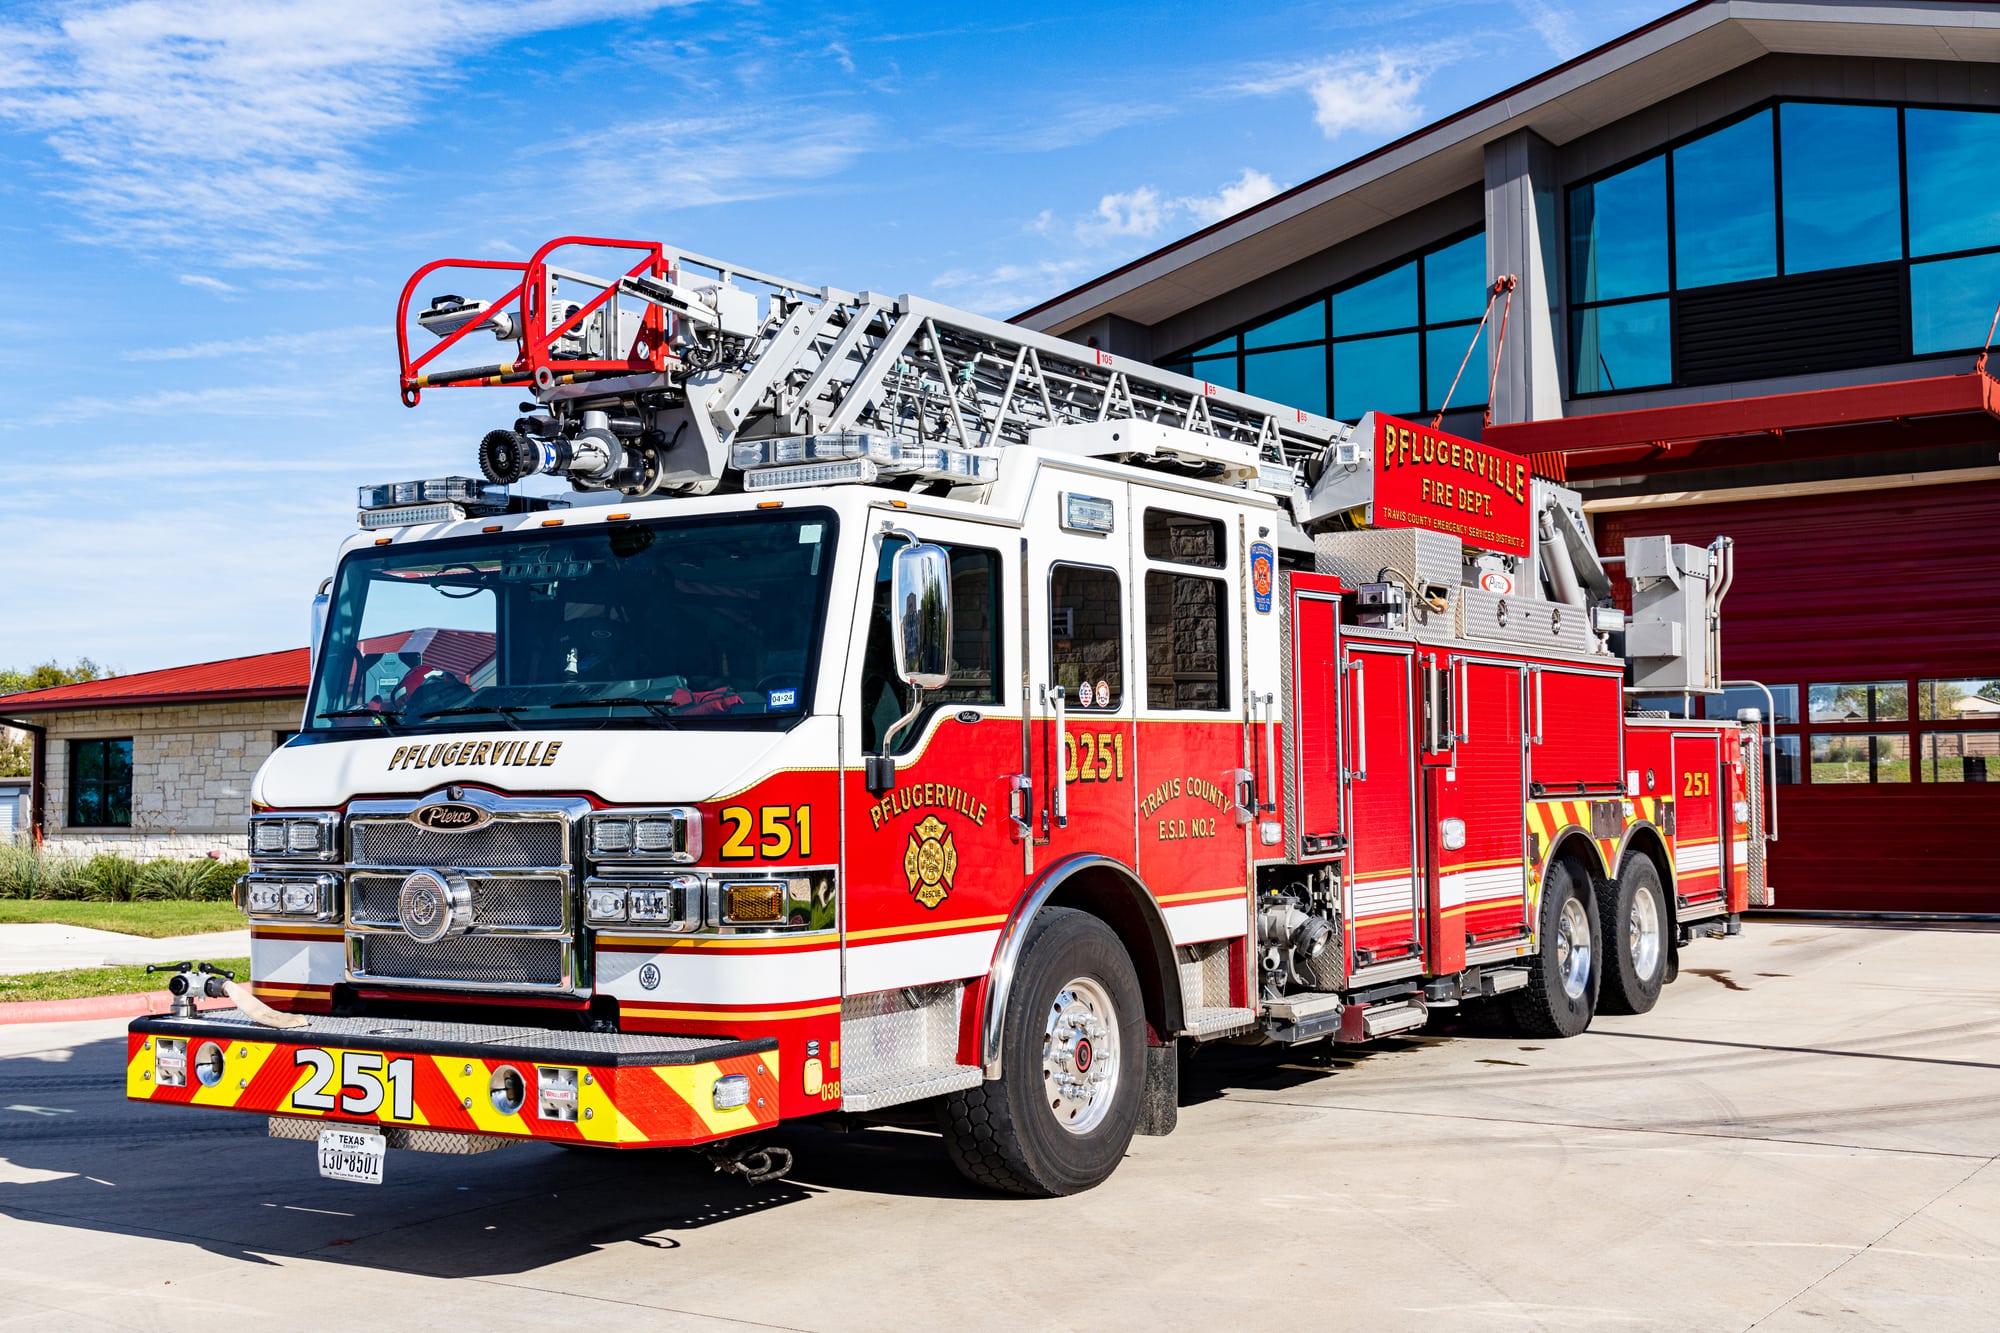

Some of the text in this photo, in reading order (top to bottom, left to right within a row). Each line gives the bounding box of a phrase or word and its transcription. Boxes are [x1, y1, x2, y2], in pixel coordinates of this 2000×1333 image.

[1101, 354, 1112, 365] 105
[1208, 385, 1217, 395] 95
[1384, 424, 1525, 504] PFLUGERVILLE
[1421, 478, 1493, 518] FIRE DEPT.
[1383, 507, 1406, 522] TRAVIS
[1407, 513, 1432, 527] COUNTY
[1433, 518, 1468, 535] EMERGENCY
[1468, 526, 1495, 541] SERVICES
[1495, 533, 1521, 546] DISTRICT
[388, 741, 563, 770] PFLUGERVILLE
[1140, 776, 1231, 819] TRAVIS COUNTY
[1683, 771, 1710, 798] 251
[428, 807, 471, 825] Pierce
[870, 783, 987, 831] PFLUGERVILLE
[719, 804, 811, 861] 251
[924, 825, 937, 833] FIRE
[1159, 820, 1187, 841] E.S.D.
[922, 890, 941, 899] RESCUE
[292, 1048, 414, 1120] 251
[821, 1081, 841, 1102] 038
[339, 1135, 364, 1145] TEXAS
